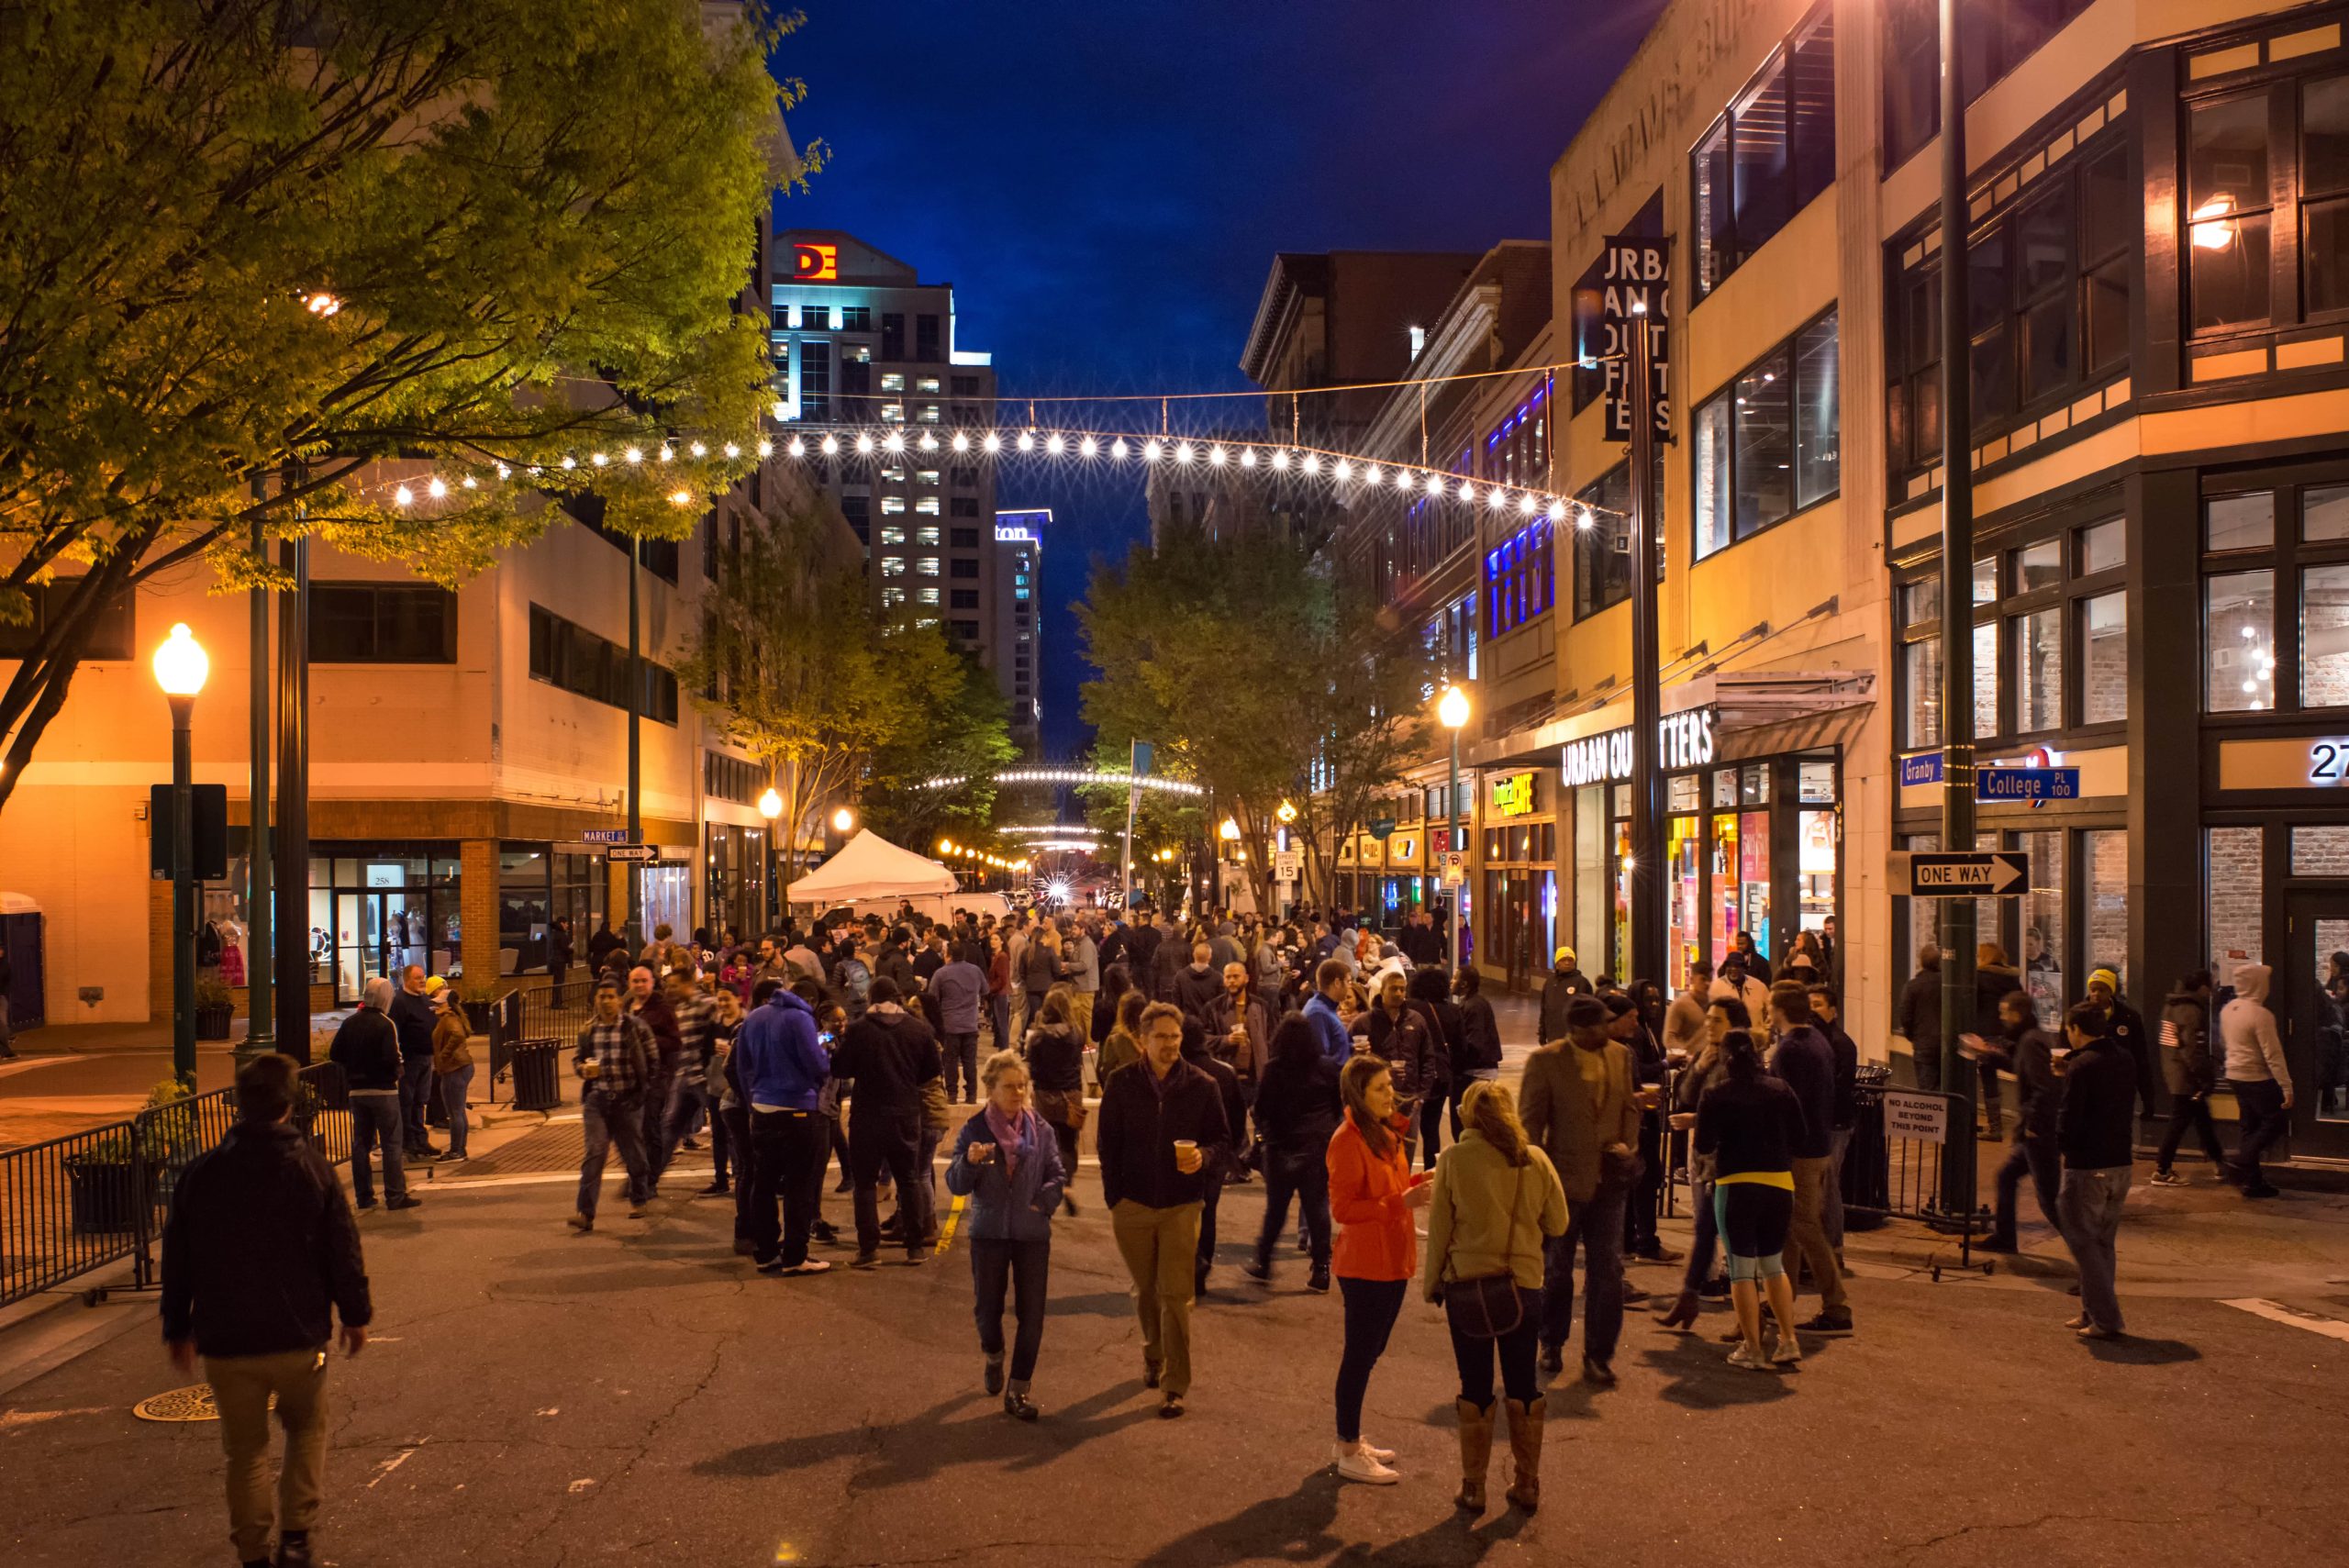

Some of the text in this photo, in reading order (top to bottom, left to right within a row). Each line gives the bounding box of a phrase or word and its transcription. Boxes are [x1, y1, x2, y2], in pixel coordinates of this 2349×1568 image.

[1562, 710, 1713, 787] URBAN OUTTERS
[1906, 759, 1934, 782] Granby
[1987, 771, 2065, 798] College PL
[2051, 784, 2070, 796] 100
[584, 831, 615, 841] MARKET
[1281, 866, 1293, 877] 15
[1920, 866, 1992, 883] ONE WAY
[1888, 1098, 1944, 1112] NO ALCOHOL
[1898, 1111, 1933, 1121] BEYOND
[1891, 1122, 1940, 1134] THIS POINT
